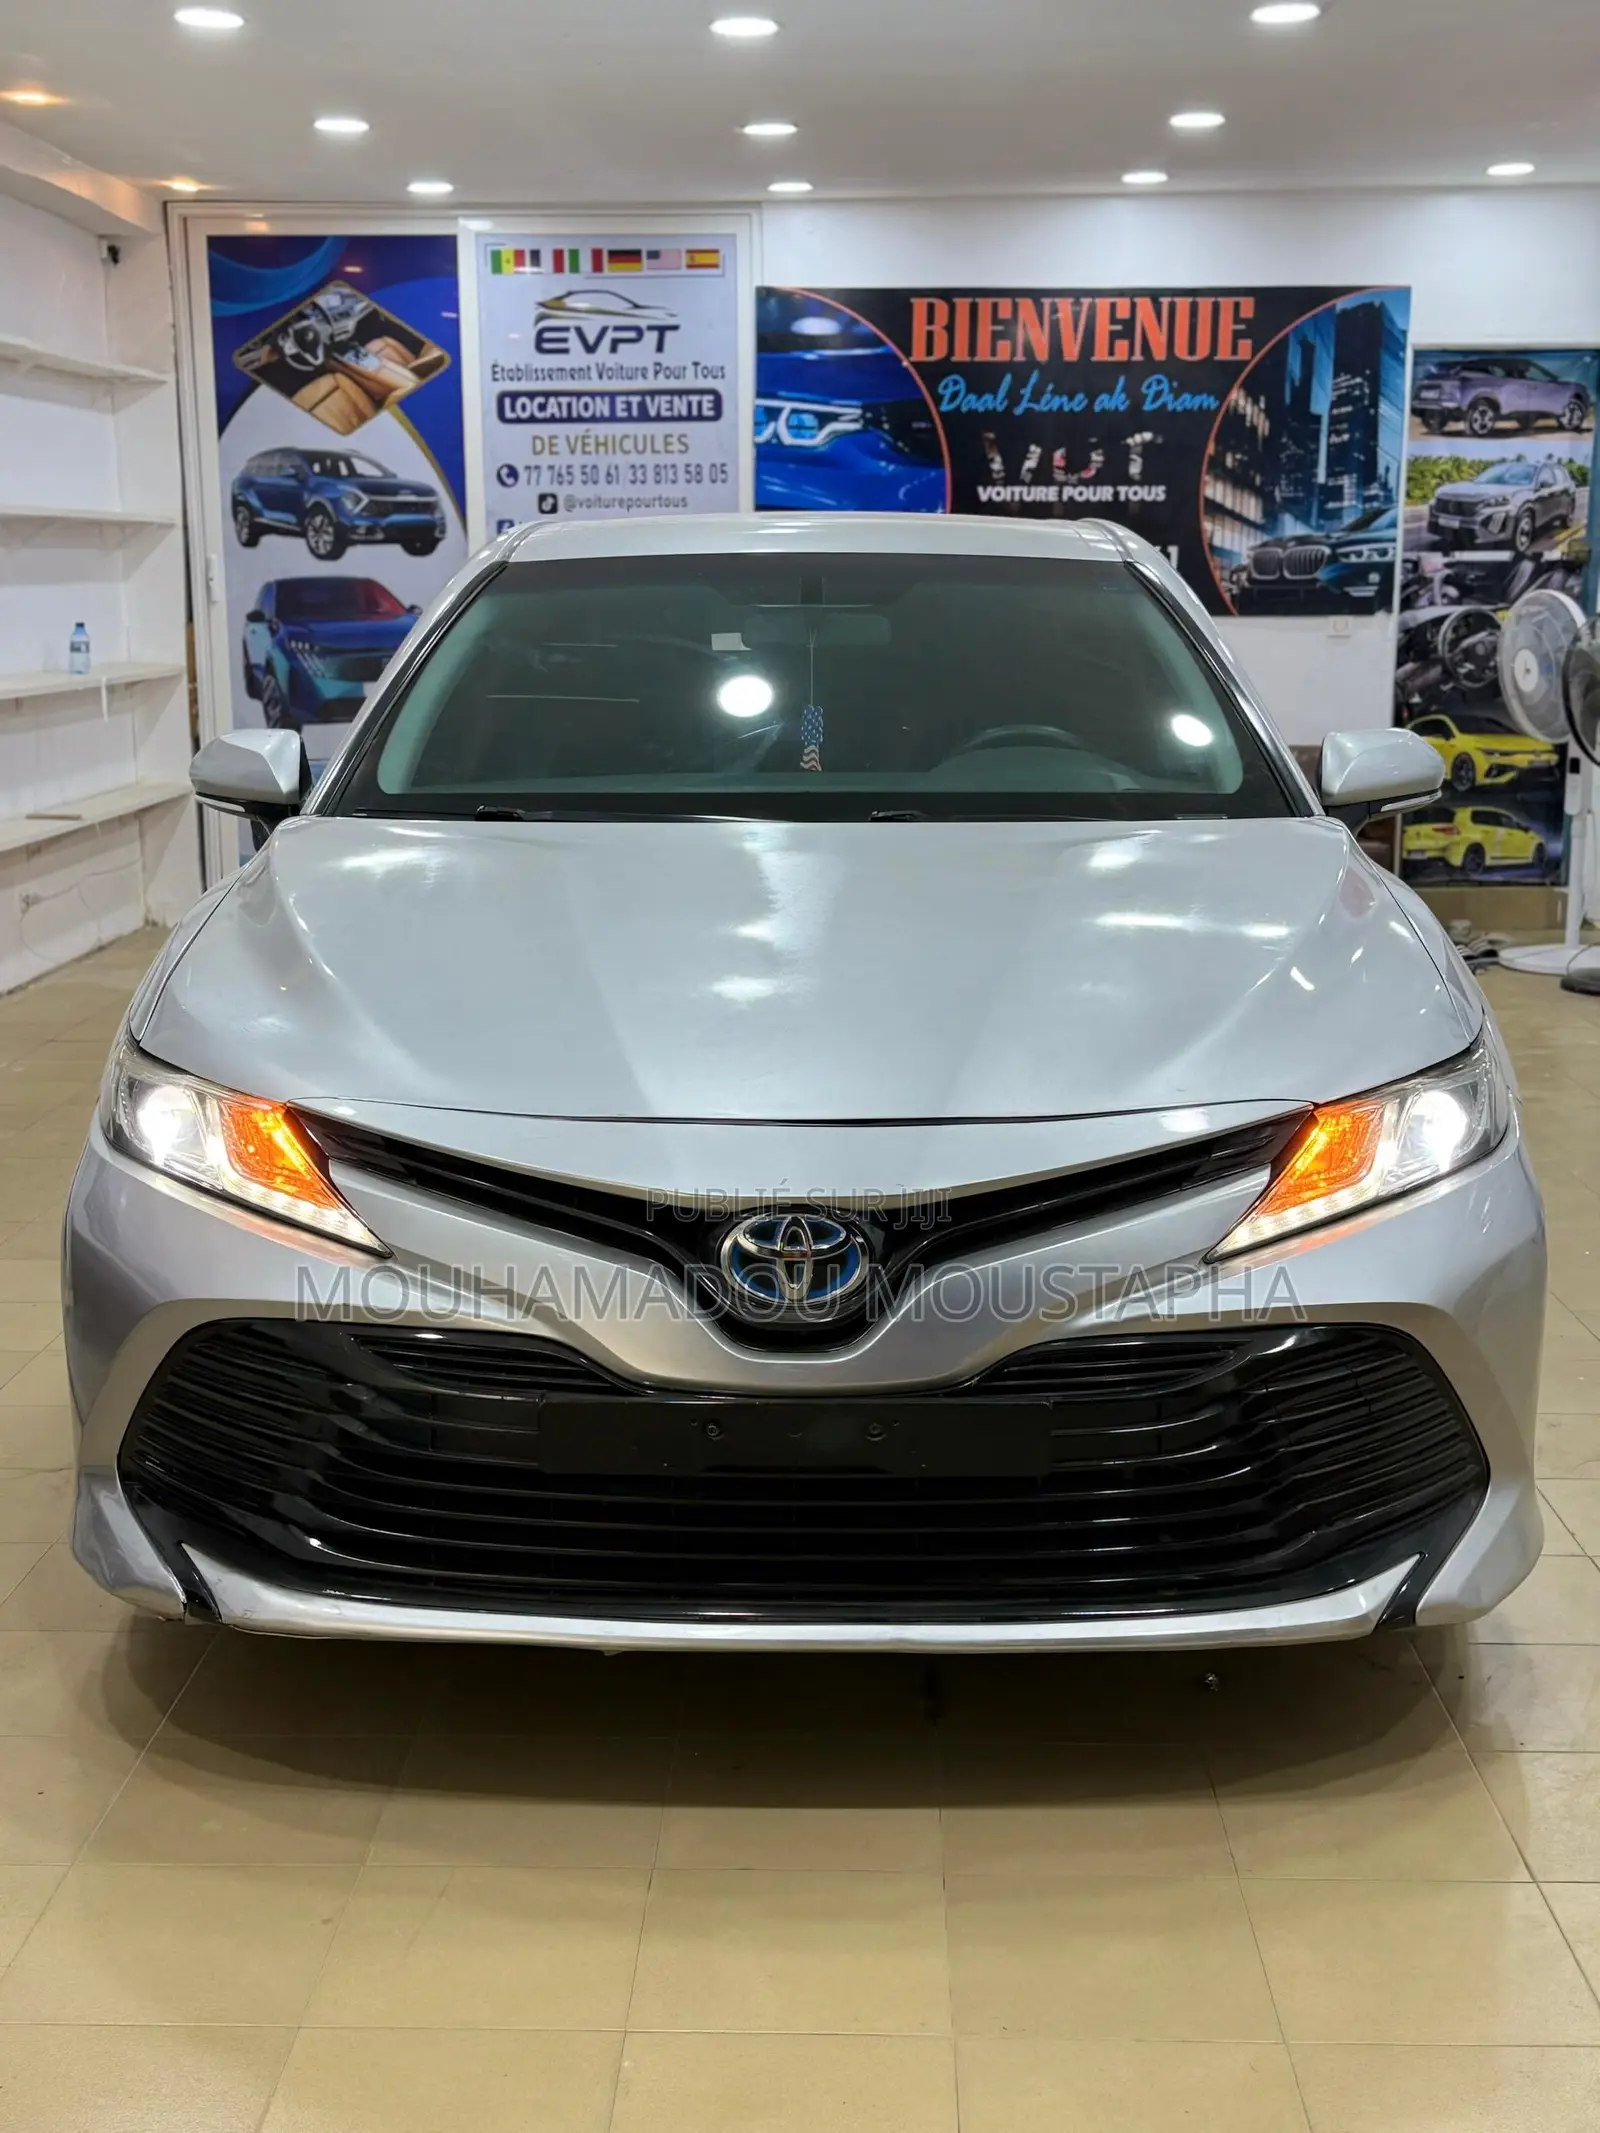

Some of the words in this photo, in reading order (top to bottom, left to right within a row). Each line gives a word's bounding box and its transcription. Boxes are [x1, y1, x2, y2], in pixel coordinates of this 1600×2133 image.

[534, 324, 681, 354] EVPT
[909, 297, 1255, 362] BIENVENUE
[491, 358, 592, 382] Établissement
[595, 363, 648, 380] Voiture
[653, 361, 687, 380] Pour
[692, 361, 726, 379] Tous
[938, 373, 1013, 413] Daal
[1093, 375, 1129, 413] ak
[1141, 374, 1219, 411] Diam
[504, 396, 611, 419] LOCATION
[615, 395, 638, 417] ET
[645, 395, 715, 417] VENTE
[532, 435, 559, 455] DE
[565, 429, 689, 454] VÉHICULES
[523, 465, 541, 486] 77
[547, 465, 574, 485] 765
[581, 465, 599, 485] 50
[605, 464, 620, 485] 61
[629, 464, 647, 485] 33
[654, 464, 678, 484] 813
[684, 463, 703, 484] 58
[709, 463, 728, 483] 05
[977, 485, 1059, 502] VOITURE
[1062, 485, 1114, 502] POUR
[1116, 485, 1166, 502] TOUS
